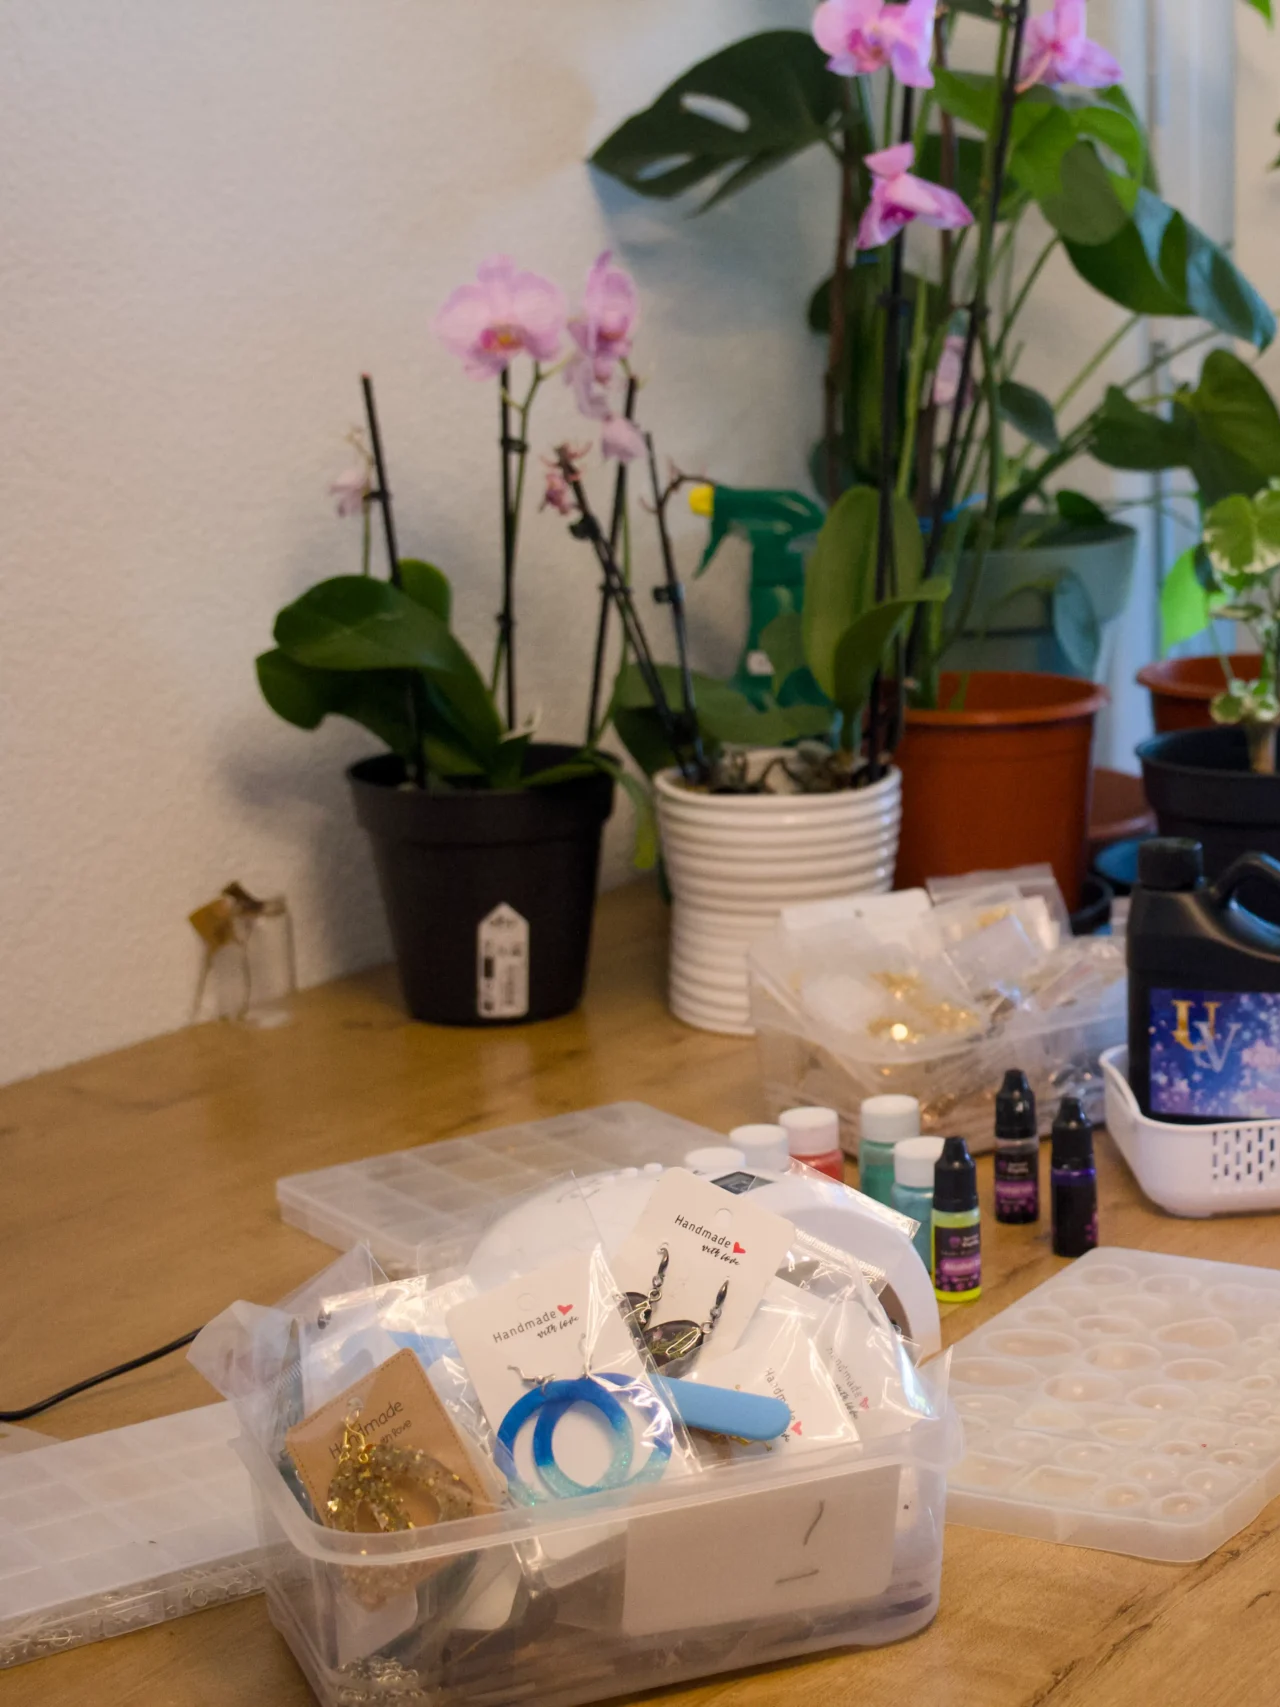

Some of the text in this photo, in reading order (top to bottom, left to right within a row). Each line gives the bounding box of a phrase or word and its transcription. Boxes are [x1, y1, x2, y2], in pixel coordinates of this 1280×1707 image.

[1171, 999, 1243, 1073] UV
[674, 1214, 731, 1248] Handmade
[701, 1244, 741, 1266] with love
[492, 1310, 557, 1344] Handmade
[537, 1315, 580, 1339] with love
[328, 1401, 404, 1459] Hndmade
